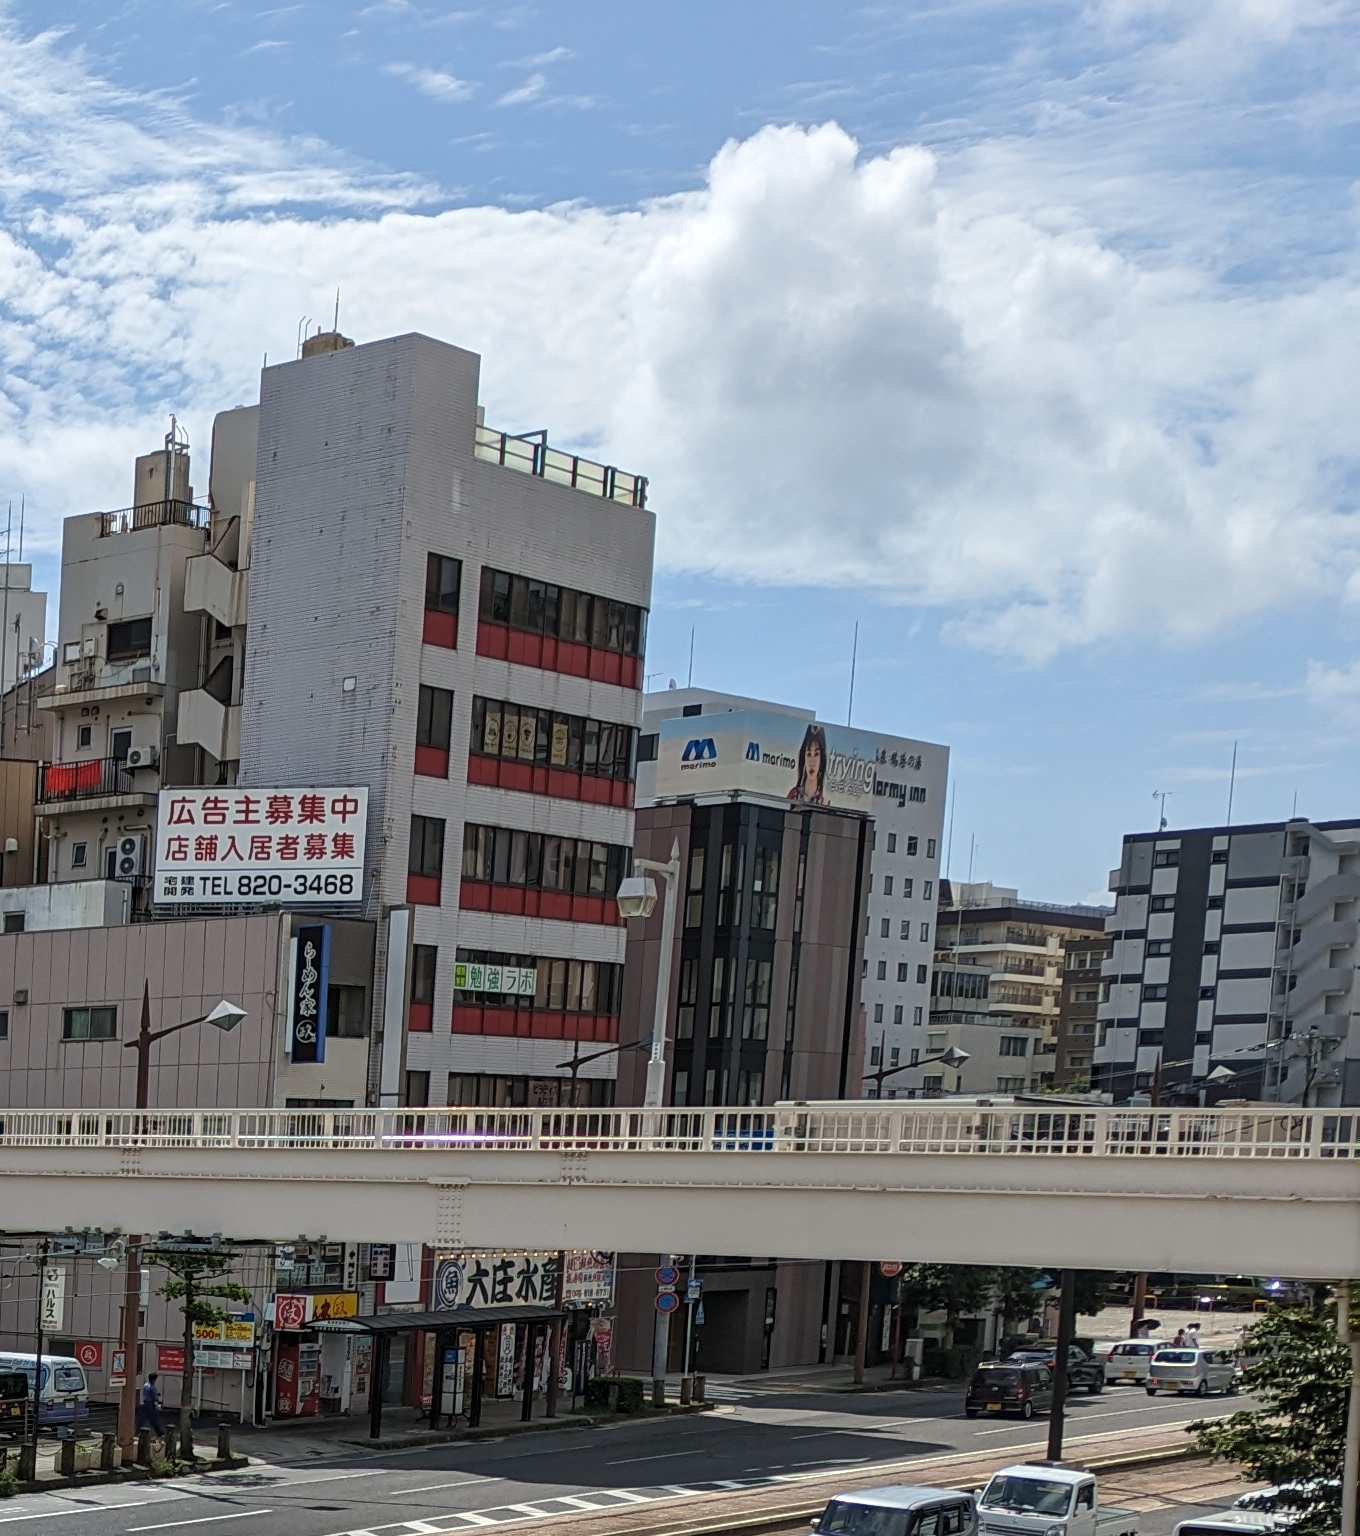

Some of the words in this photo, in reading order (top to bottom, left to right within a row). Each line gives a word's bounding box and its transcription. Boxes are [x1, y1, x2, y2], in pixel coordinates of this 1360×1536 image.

[681, 760, 717, 771] marimo
[762, 751, 796, 770] marimo
[829, 747, 876, 794] trying
[167, 794, 359, 826] 広告主募集中
[164, 831, 356, 862] 店舗入居者募集
[199, 876, 233, 896] TEL
[237, 874, 354, 896] 820-3468
[469, 968, 535, 991] 勉強ラボ
[465, 1257, 558, 1305] 大庄水産
